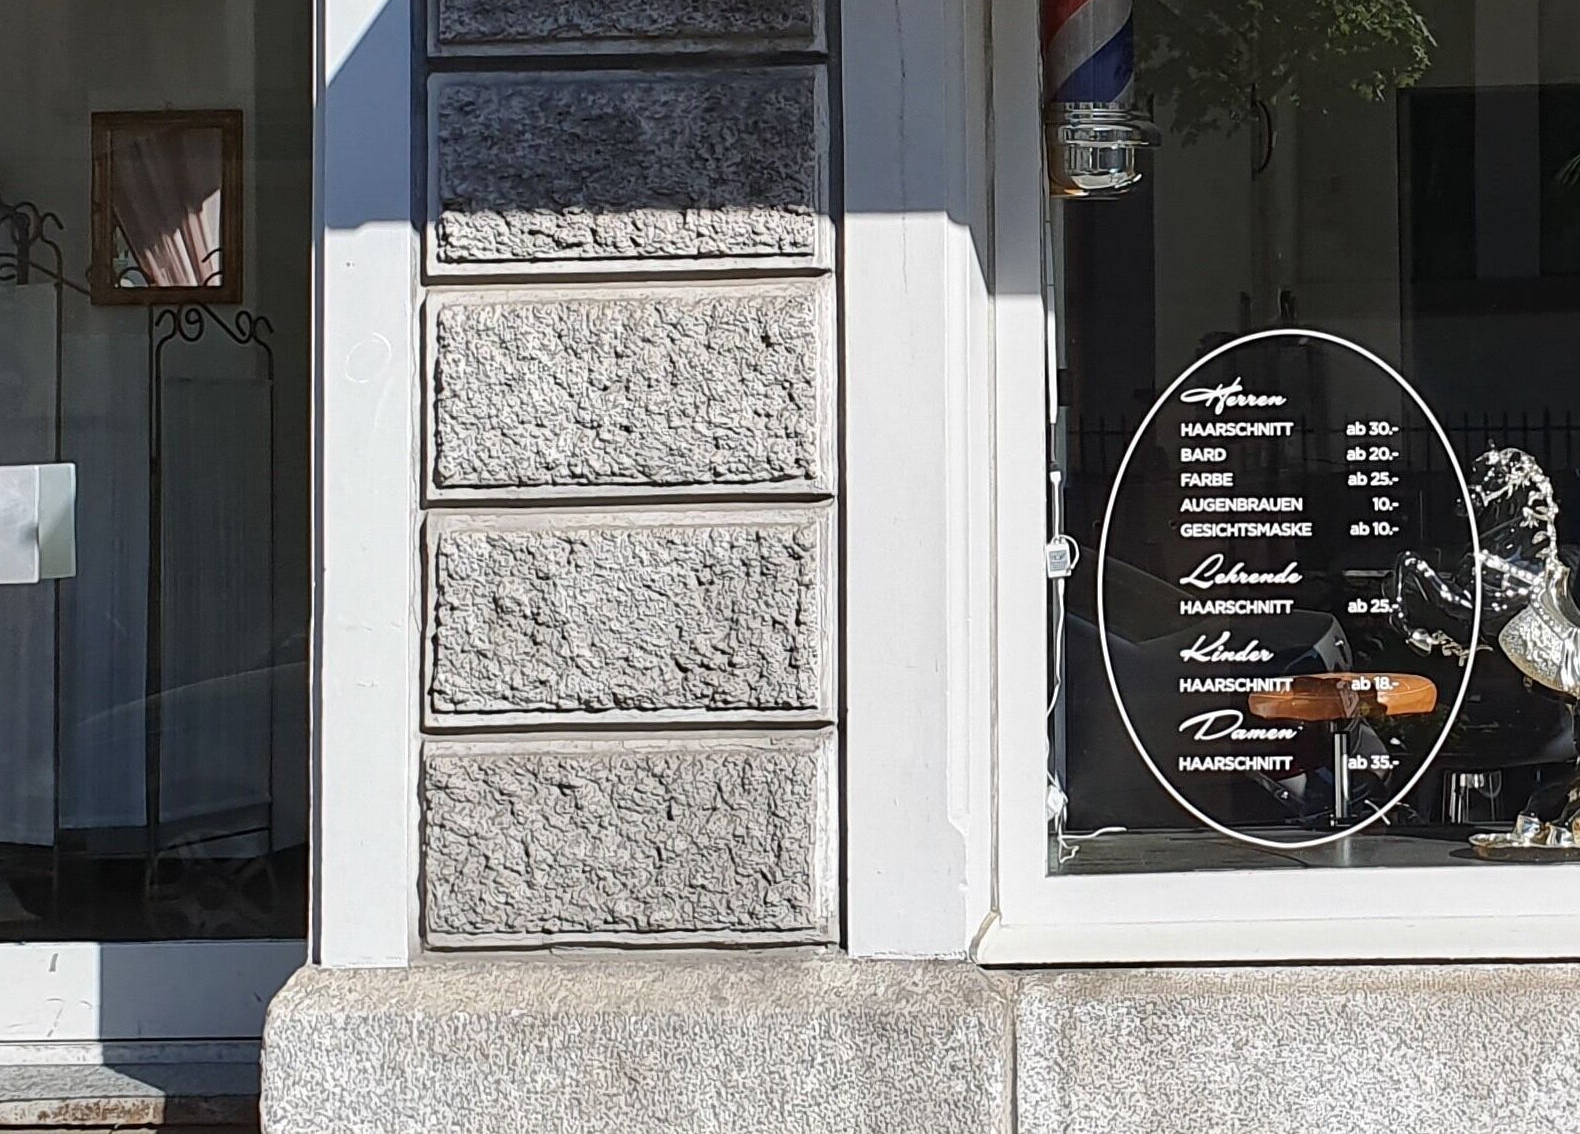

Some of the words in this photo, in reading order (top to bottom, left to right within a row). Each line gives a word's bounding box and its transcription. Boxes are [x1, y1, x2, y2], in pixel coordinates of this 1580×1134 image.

[1180, 377, 1286, 415] Herren
[1180, 422, 1294, 437] HAARSCHNITT
[1346, 421, 1366, 435] ab
[1368, 421, 1399, 435] 30.-
[1180, 447, 1227, 462] BARD
[1346, 446, 1366, 461] ab
[1368, 446, 1399, 461] 20.-
[1180, 472, 1233, 487] FARBE
[1347, 471, 1367, 486] ab
[1370, 471, 1399, 486] 25.-
[1180, 497, 1303, 512] AUGENBRAUEN
[1372, 496, 1399, 511] 10.-
[1180, 522, 1312, 537] GESICHTSMASKE
[1349, 521, 1369, 536] ab
[1372, 521, 1399, 536] 10.-
[1179, 553, 1303, 589] Lehrende
[1180, 599, 1294, 614] HAARSCHNITT
[1347, 598, 1367, 613] ab
[1370, 599, 1399, 613] 25.-
[1179, 631, 1274, 662] Kinder
[1179, 678, 1294, 692] HAARSCHNITT
[1351, 676, 1370, 691] ab
[1374, 677, 1399, 691] 18.-
[1178, 709, 1297, 740] Damen
[1178, 756, 1294, 771] HAARSCHNITT
[1348, 754, 1367, 769] ab
[1370, 755, 1399, 769] 35.-
